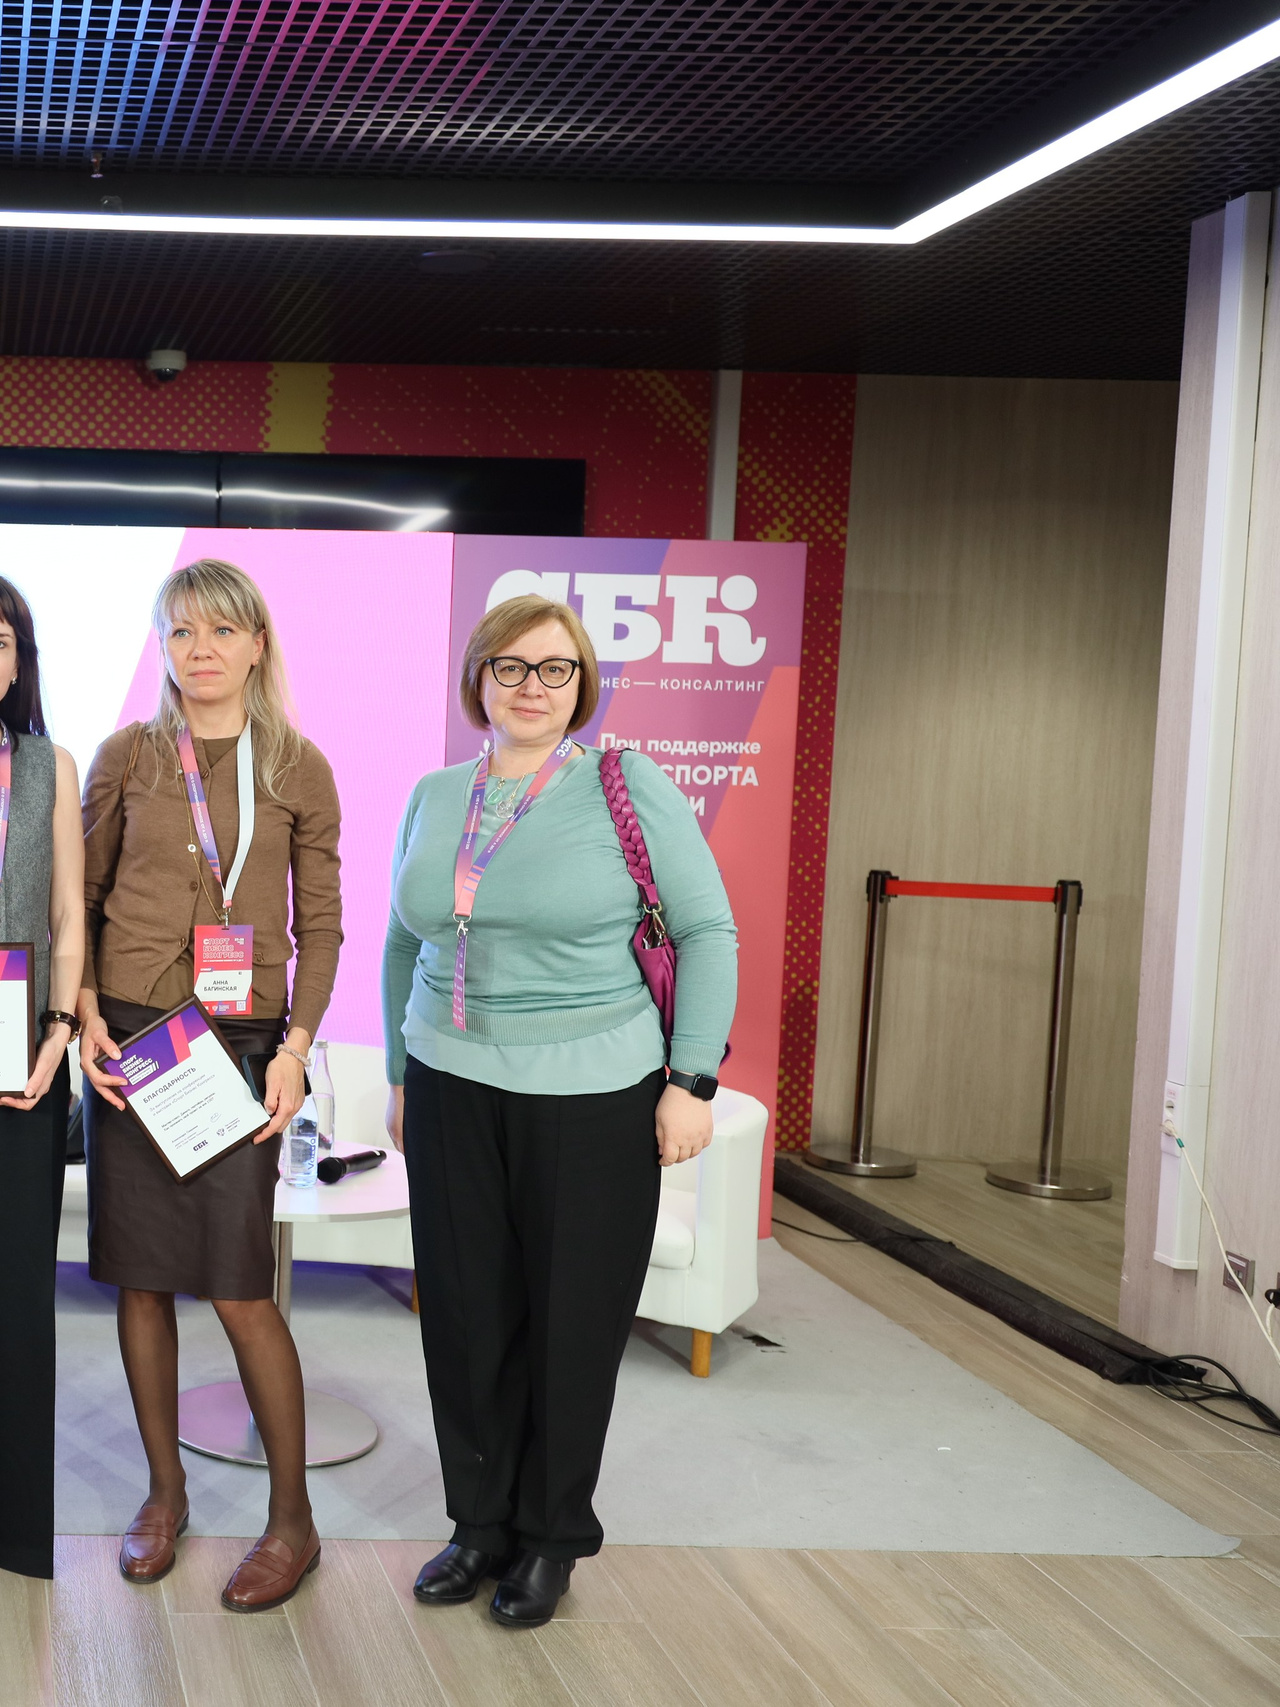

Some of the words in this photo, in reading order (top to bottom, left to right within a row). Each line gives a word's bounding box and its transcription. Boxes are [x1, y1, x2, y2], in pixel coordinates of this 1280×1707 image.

[660, 678, 765, 692] КОНСАЛТИНГ
[647, 739, 761, 757] поддержке
[143, 1067, 196, 1103] БЛАГОДАРНОСТЬ
